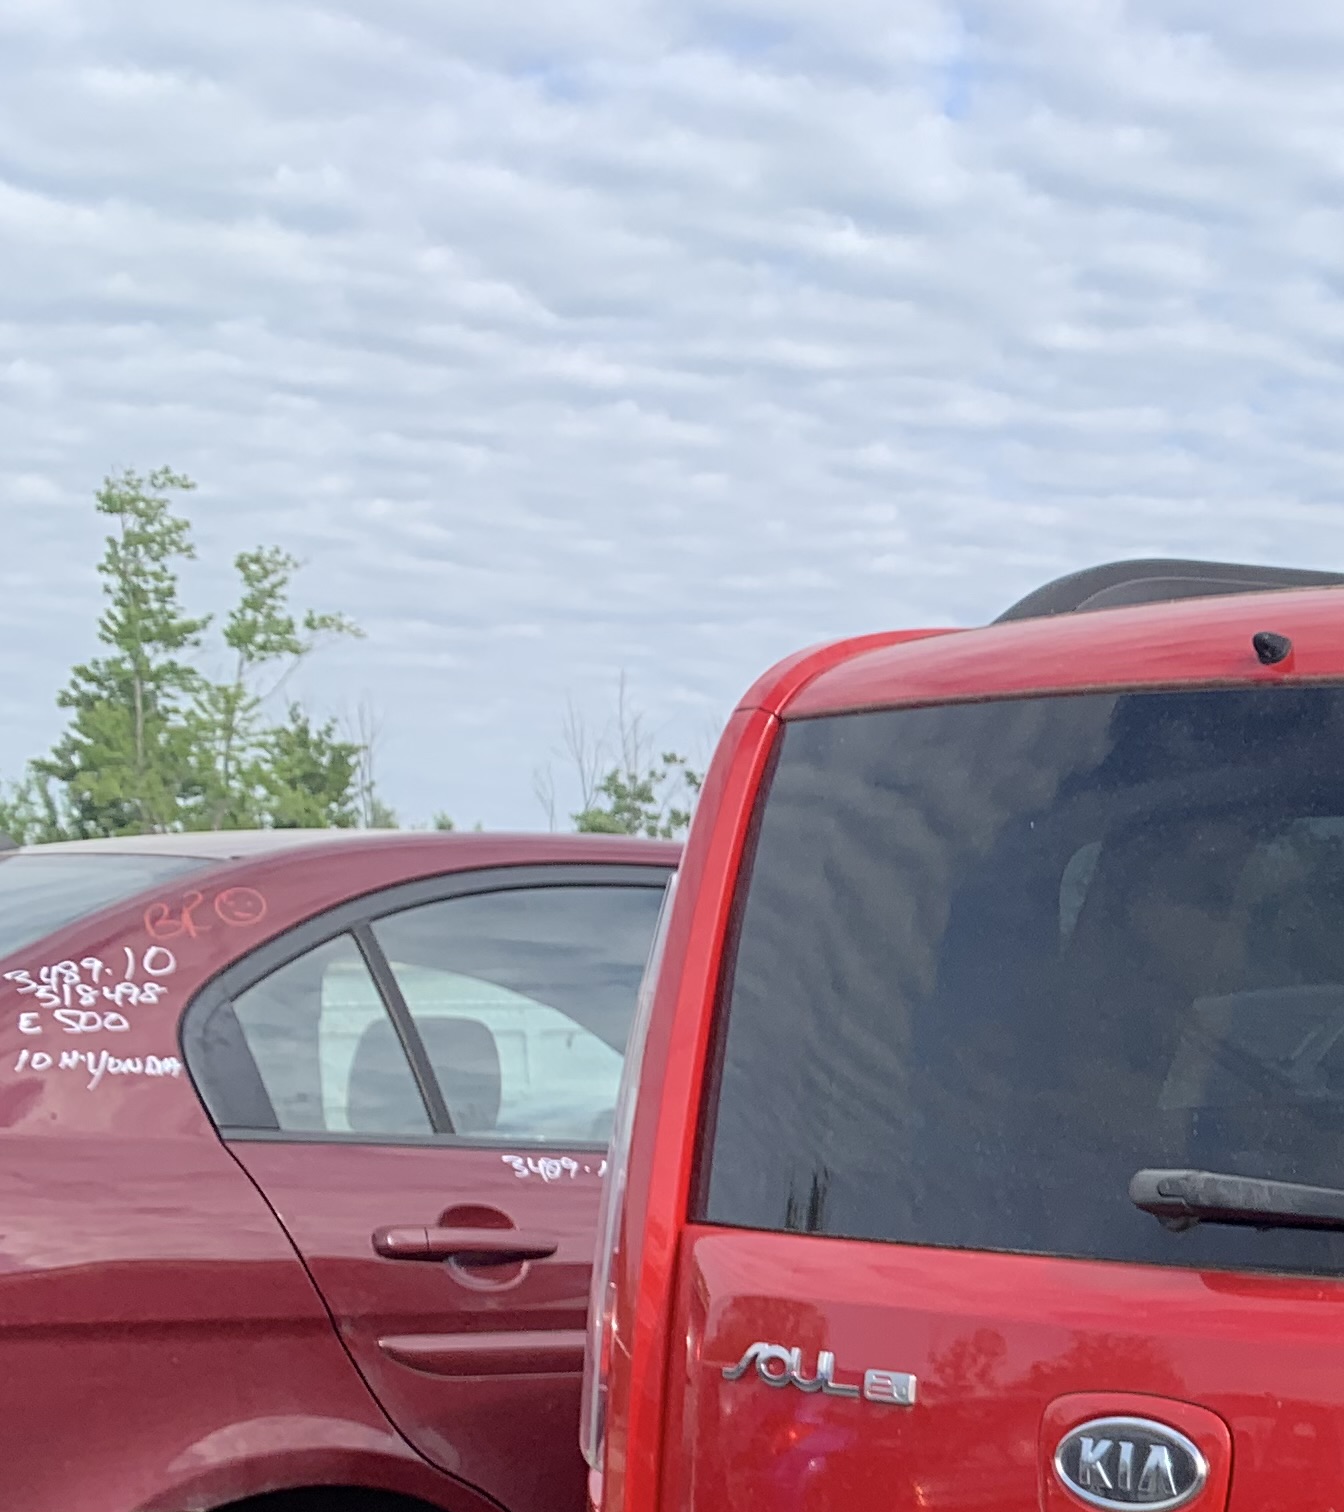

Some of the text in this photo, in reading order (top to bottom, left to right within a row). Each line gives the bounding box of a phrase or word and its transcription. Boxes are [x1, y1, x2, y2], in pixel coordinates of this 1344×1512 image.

[18, 1012, 43, 1035] E
[13, 1049, 52, 1073] 10
[1077, 1436, 1179, 1497] KIA
